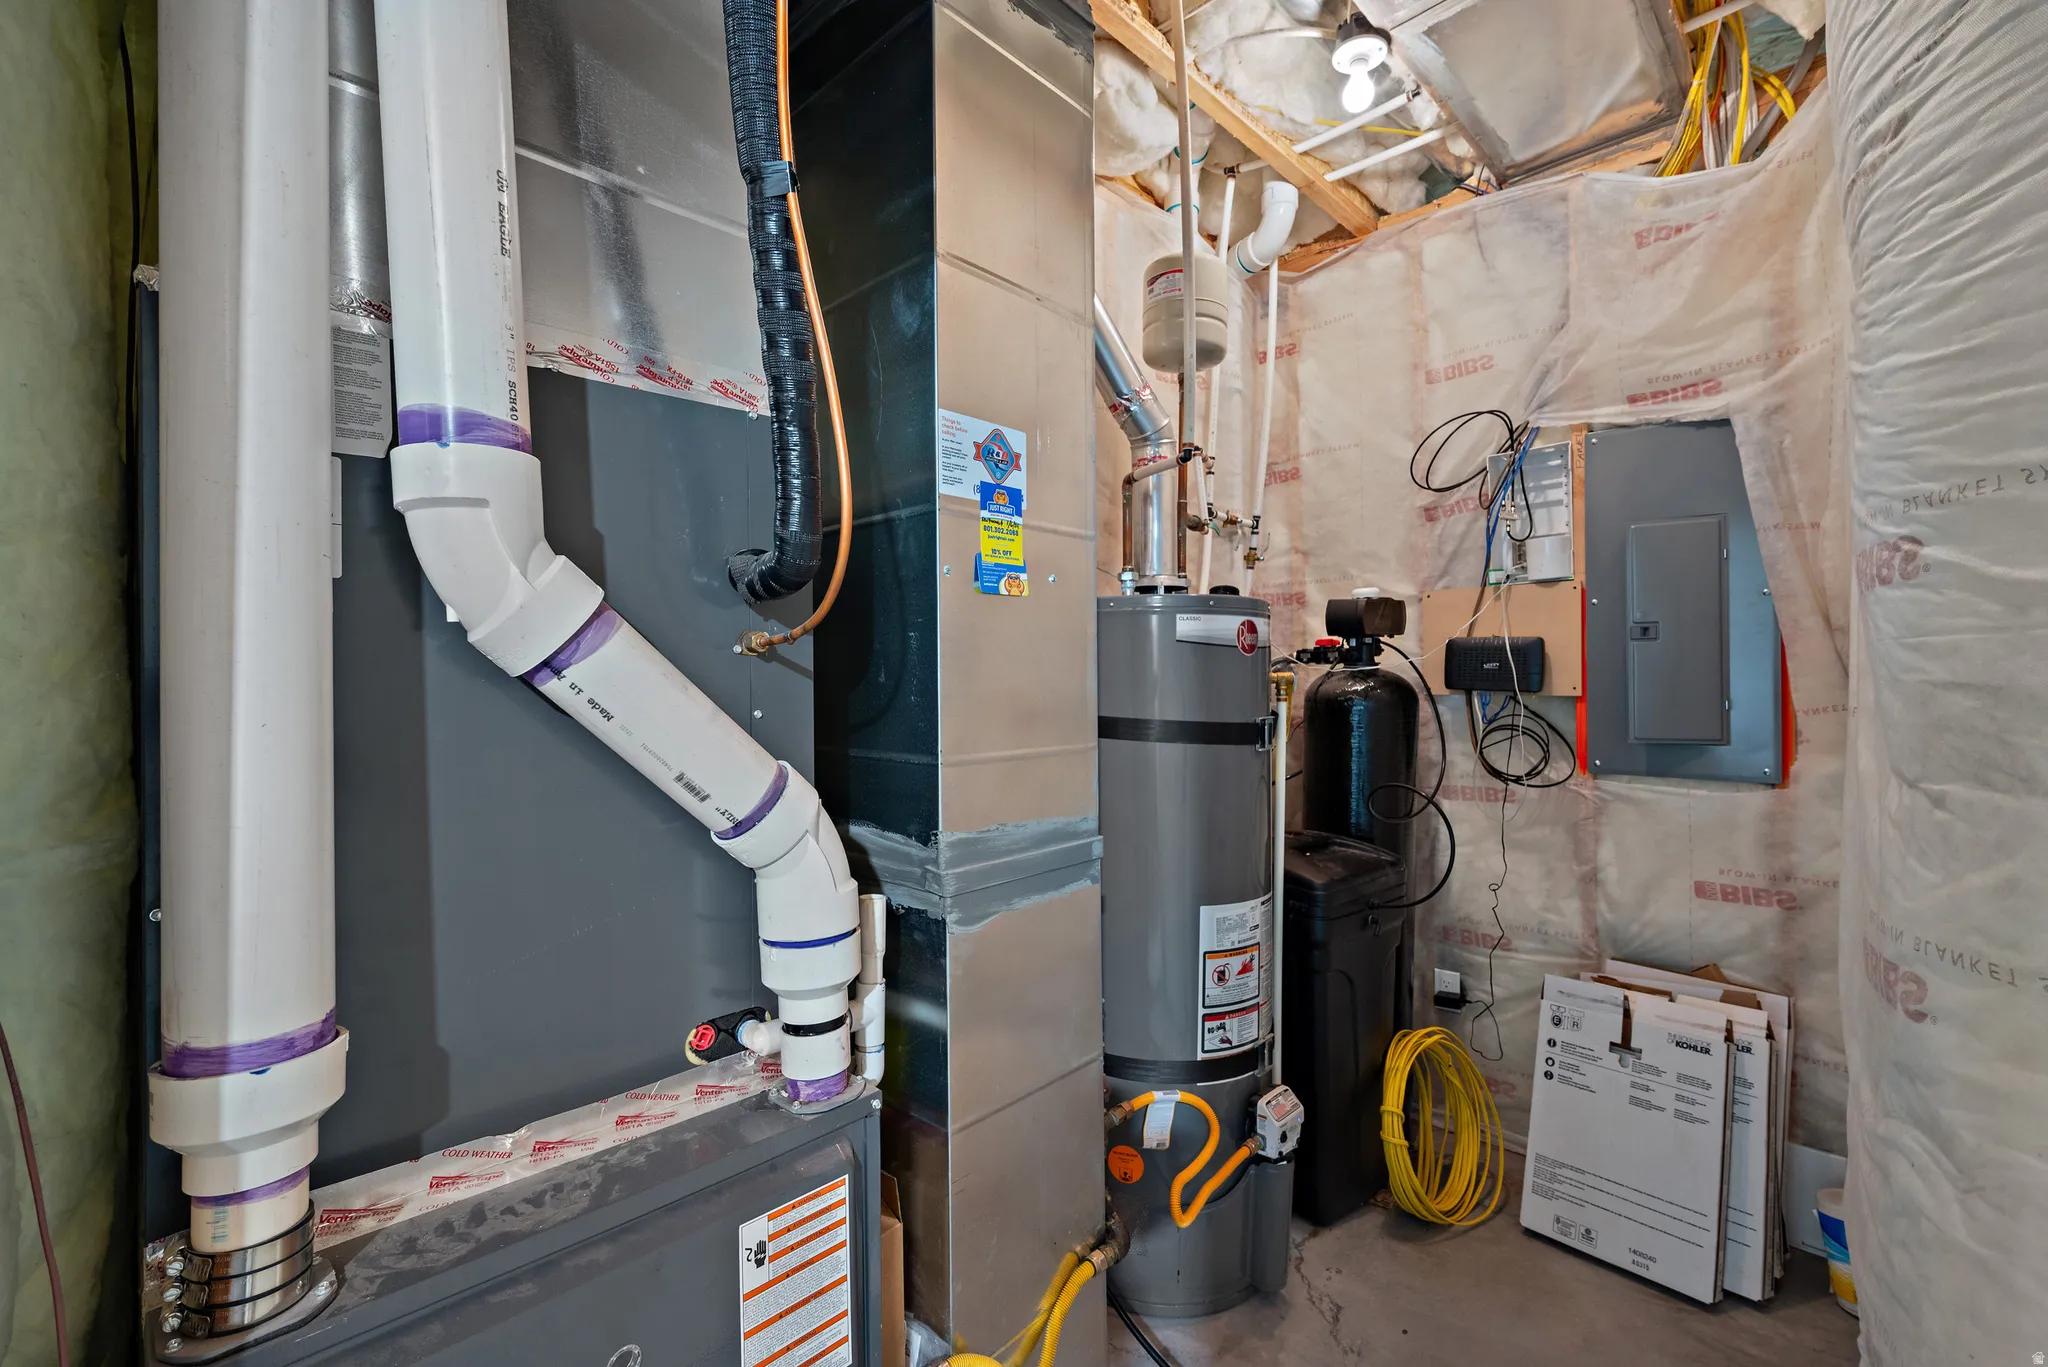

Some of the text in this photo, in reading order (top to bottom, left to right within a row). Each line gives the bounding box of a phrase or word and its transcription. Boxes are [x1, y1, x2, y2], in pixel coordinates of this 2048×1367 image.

[558, 344, 612, 374] ntureTape
[508, 380, 519, 421] SCH40
[941, 416, 956, 424] Things
[990, 504, 1013, 514] JUST RIGHT
[991, 548, 1001, 556] 10%
[1239, 619, 1258, 650] Rheem
[569, 682, 584, 696] in
[587, 697, 614, 722] Made
[1678, 1034, 1695, 1043] BOLD
[1675, 1040, 1713, 1056] KOHLER
[625, 1091, 681, 1101] COLD WEATHER
[615, 1112, 677, 1127] VentureTape
[532, 1138, 599, 1153] VentureTape
[441, 1149, 514, 1160] COLD WEATHER
[429, 1171, 505, 1190] VentureTape
[320, 1207, 404, 1224] VentureTape
[1628, 1247, 1657, 1264] 1408240
